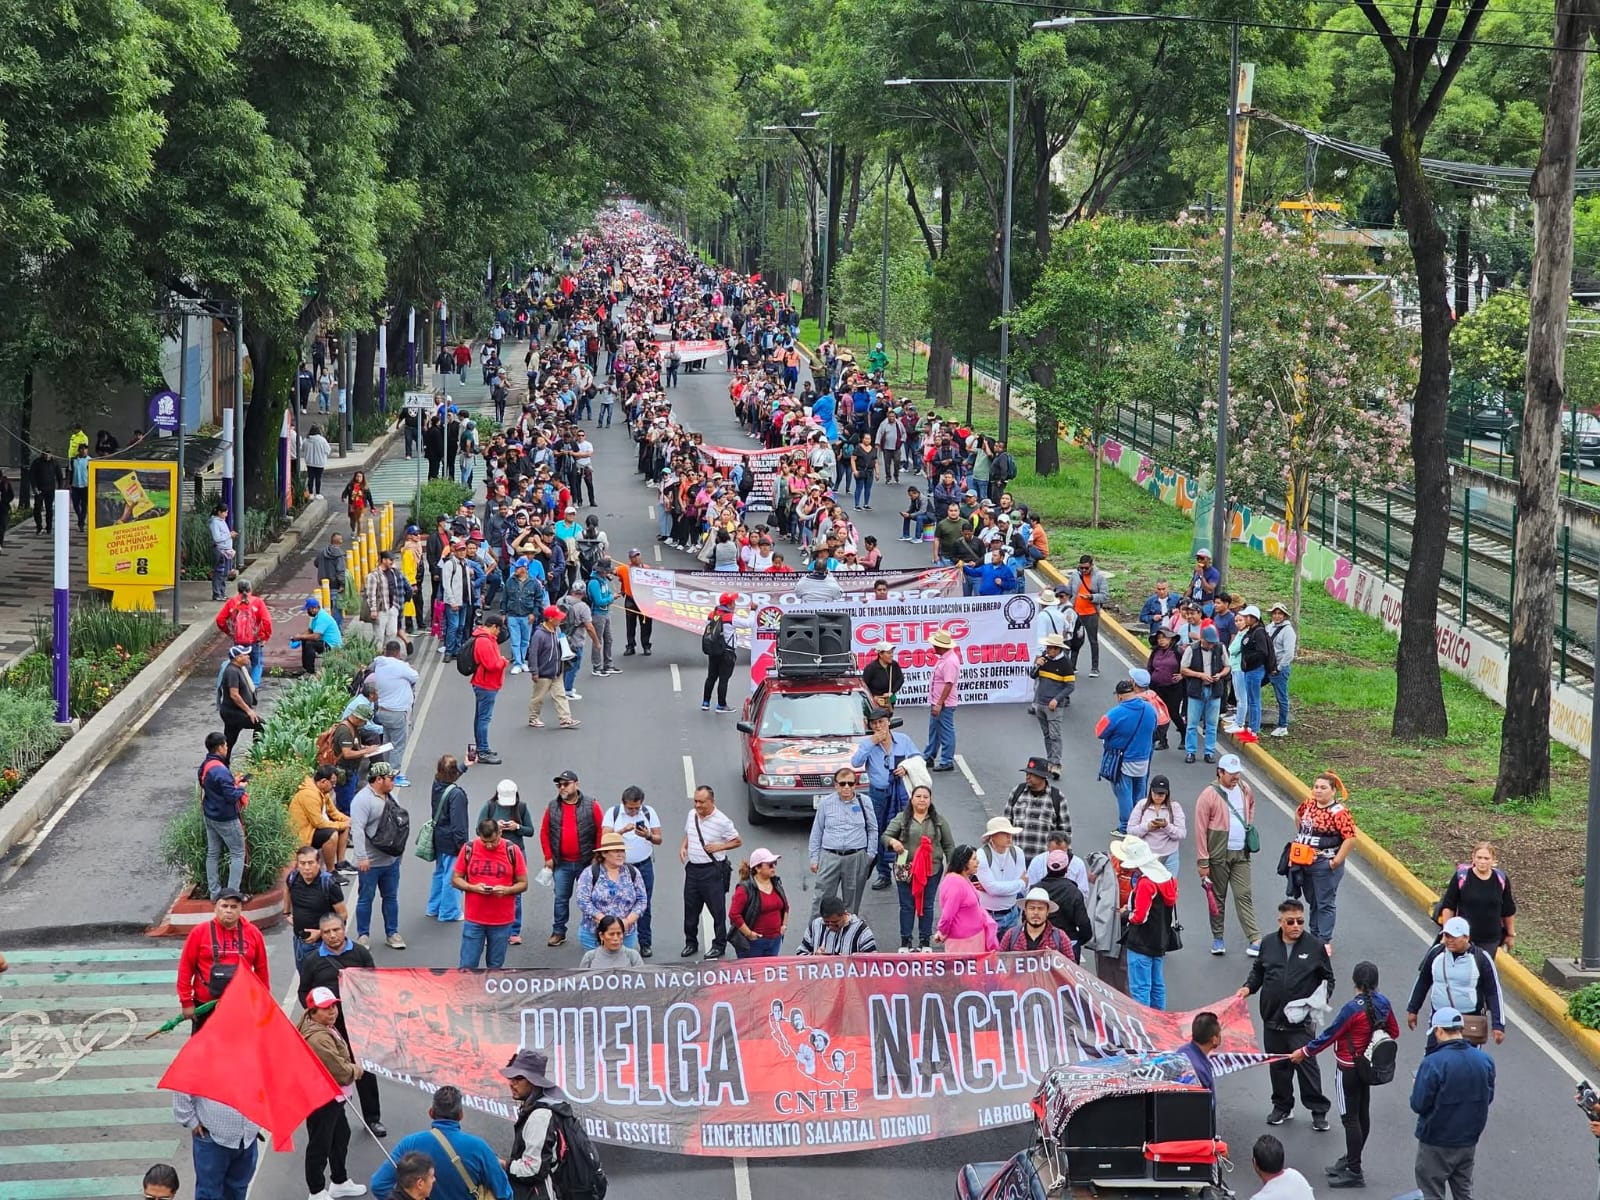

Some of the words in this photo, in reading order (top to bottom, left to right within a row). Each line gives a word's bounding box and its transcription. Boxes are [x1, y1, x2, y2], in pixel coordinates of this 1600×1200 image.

[107, 541, 125, 549] COPA
[127, 534, 158, 545] MUNDIAL
[130, 544, 145, 552] FIFA
[859, 606, 866, 617] DE
[867, 604, 912, 617] TRABAJADORES
[913, 604, 920, 616] DE
[921, 604, 928, 615] LA
[929, 601, 962, 615] EDUCACIÓN
[963, 603, 971, 613] EN
[972, 601, 1002, 613] GUERRERO
[967, 643, 1030, 664] CHICA
[980, 667, 989, 678] SE
[964, 693, 989, 701] CHICA
[470, 859, 507, 879] GAP
[485, 973, 647, 994] COORDINADORA
[654, 970, 756, 988] NACIONAL
[764, 966, 788, 983] DE
[796, 960, 945, 981] TRABAJADORES
[953, 959, 977, 976] DE
[984, 958, 1007, 975] LA
[517, 1001, 750, 1107] HUELGA
[774, 1089, 859, 1115] CNTE
[585, 1117, 611, 1139] DEL
[614, 1120, 671, 1145] ISSSTE!
[702, 1122, 800, 1147] ¡INCREMENTO
[805, 1118, 877, 1144] SALARIAL
[880, 1114, 932, 1138] DIGNO!
